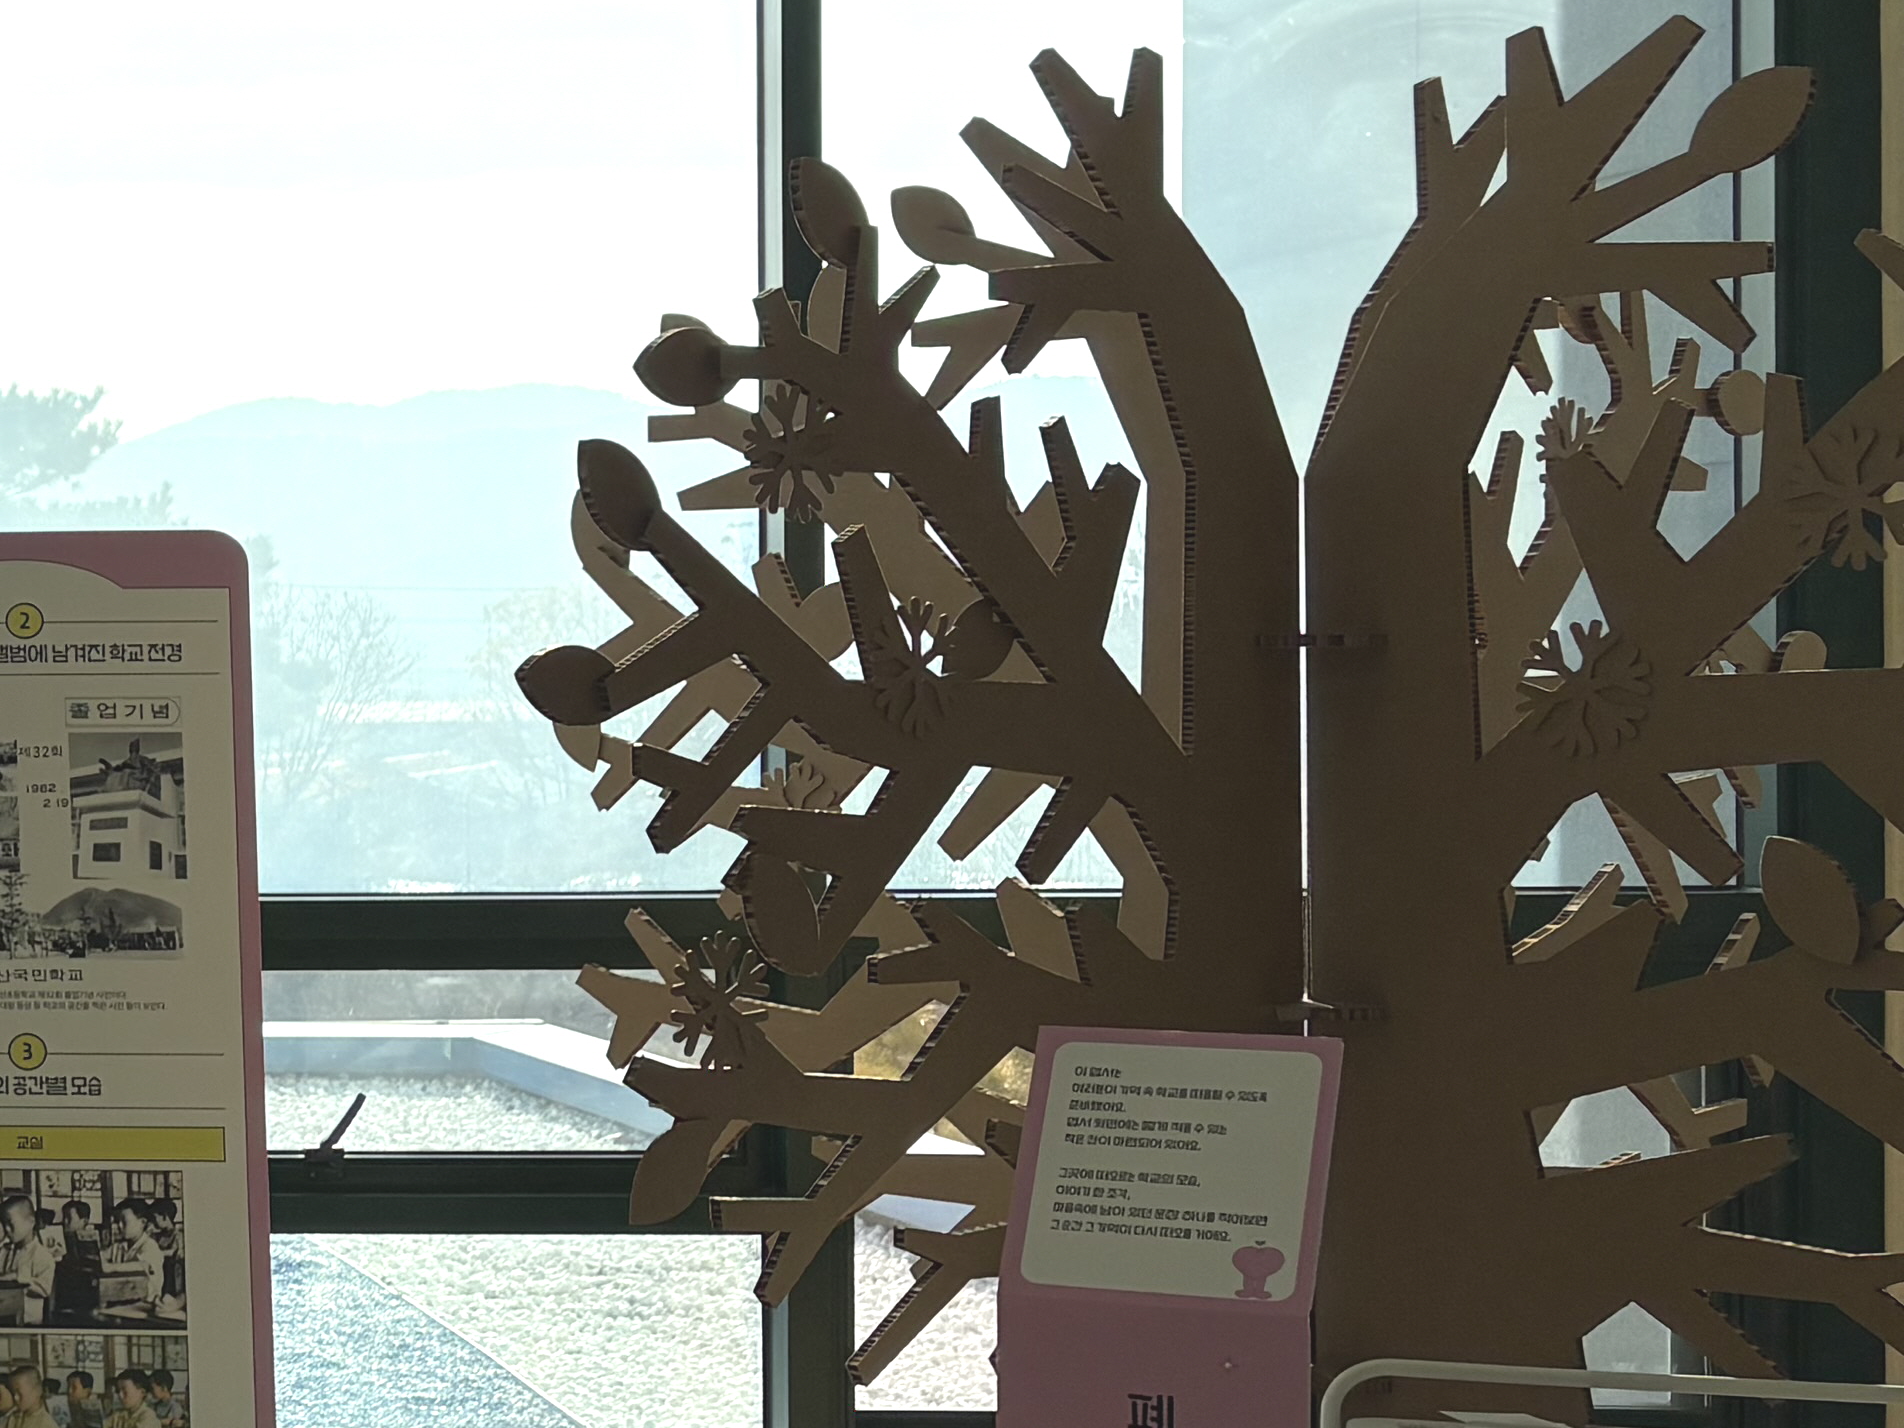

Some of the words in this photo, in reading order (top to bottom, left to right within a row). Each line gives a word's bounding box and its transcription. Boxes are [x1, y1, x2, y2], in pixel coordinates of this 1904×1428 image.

[20, 612, 30, 629] 2
[52, 644, 106, 663] 남겨진
[109, 643, 144, 662] 학교
[147, 643, 182, 662] 전경
[18, 745, 62, 759] 제32회
[26, 783, 56, 793] 1982
[23, 1042, 32, 1060] 3
[13, 1076, 68, 1096] 공간별
[71, 1077, 101, 1096] 모습
[16, 1136, 43, 1150] 교실
